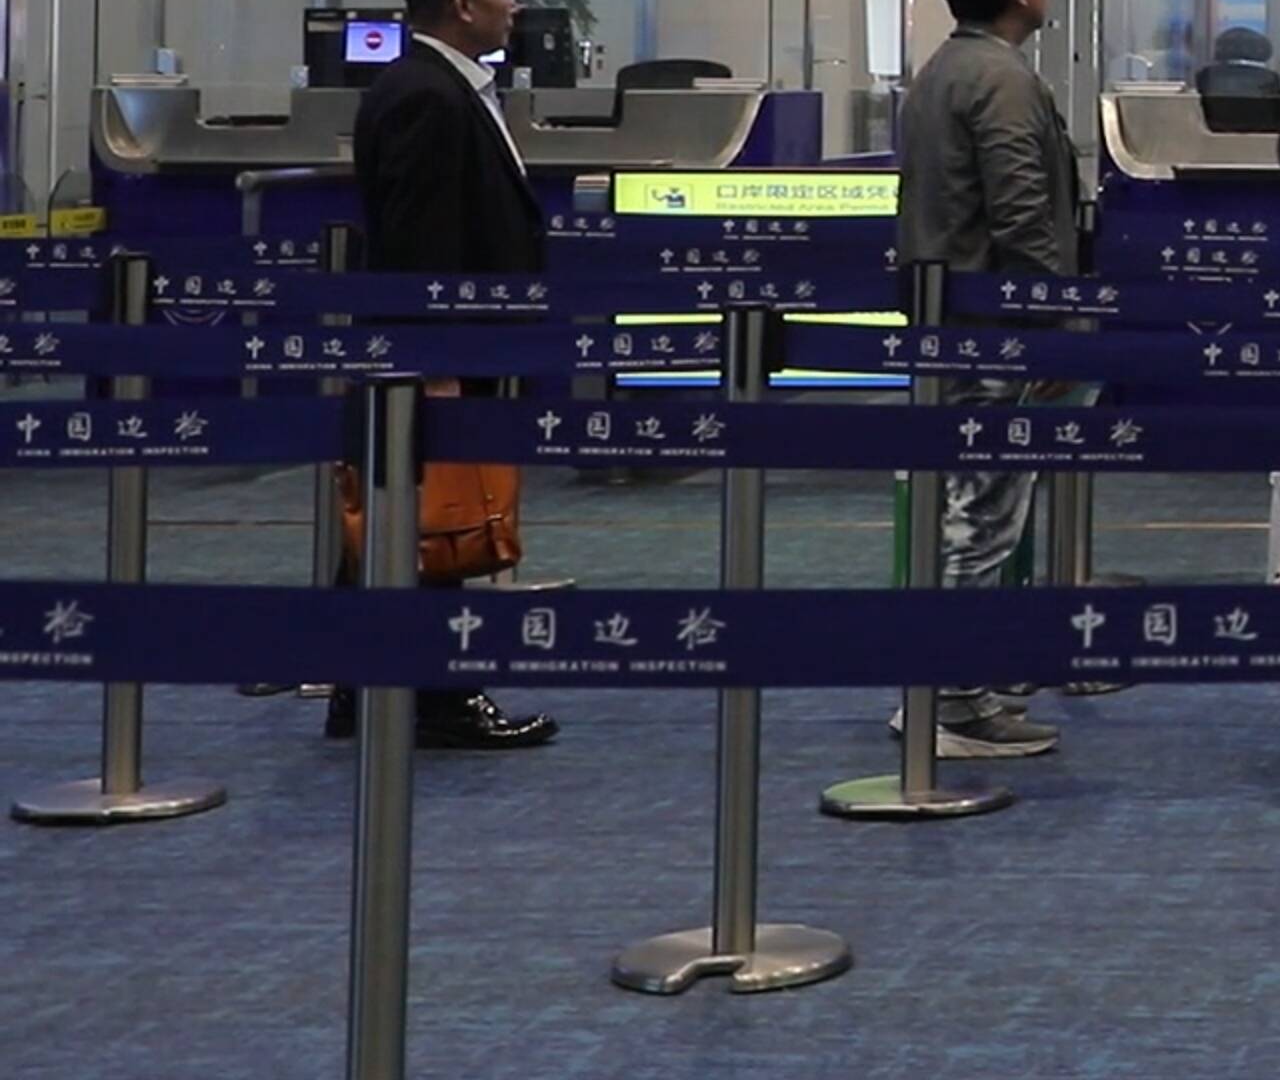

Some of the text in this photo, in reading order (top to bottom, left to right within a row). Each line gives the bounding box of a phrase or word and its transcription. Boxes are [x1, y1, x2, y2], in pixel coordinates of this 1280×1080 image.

[16, 411, 208, 443] 中国边检
[536, 410, 725, 442] 中国边检
[959, 417, 1143, 447] 中国边检
[448, 606, 726, 651] 中国边检
[447, 660, 727, 672] CHINA IMMIGRATION INSPECTION
[1071, 657, 1120, 668] CHINA
[1132, 655, 1239, 667] IMMIGRATION
